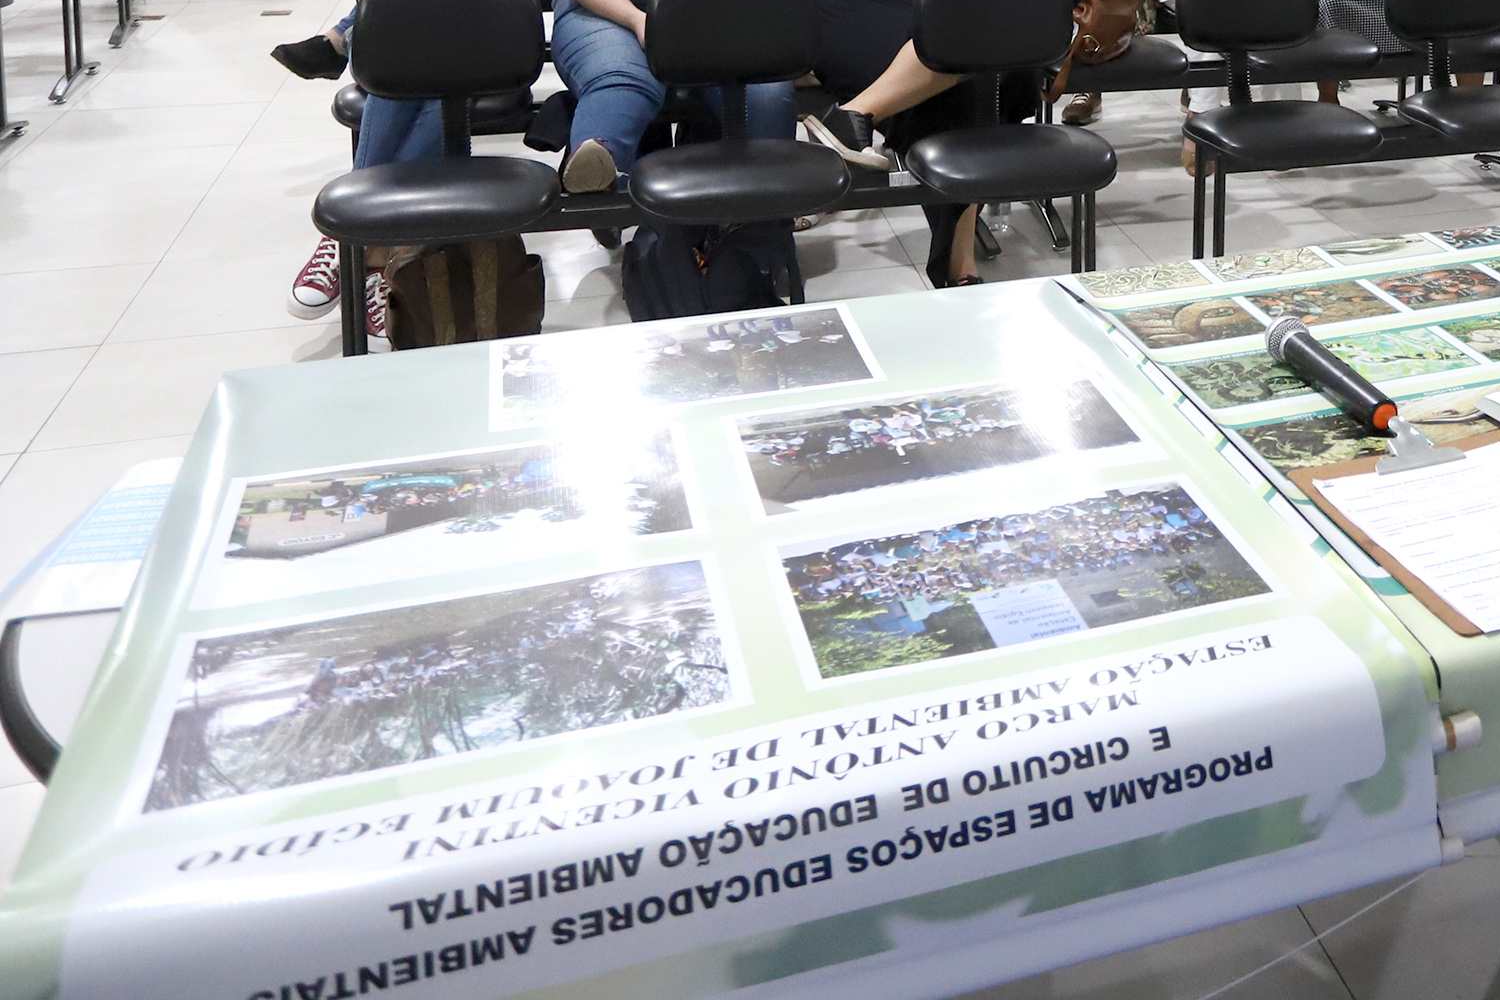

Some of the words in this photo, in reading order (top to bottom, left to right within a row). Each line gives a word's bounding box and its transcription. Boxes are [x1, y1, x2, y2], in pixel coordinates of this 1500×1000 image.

[283, 535, 326, 545] EGYDIO
[992, 610, 1023, 621] Egídio
[1022, 609, 1071, 623] Ambiental
[1029, 624, 1081, 639] Ambiental
[1037, 616, 1076, 628] Estação
[1088, 633, 1276, 686] ESTAÇÃO
[800, 677, 1071, 748] AMBIENTAL
[976, 689, 1142, 741] MARCO
[1148, 725, 1172, 752] E
[711, 736, 783, 772] DE
[722, 728, 959, 801] ANTÔNIO
[961, 736, 1131, 797] CIRCUITO
[1083, 745, 1275, 814] PROGRAMA
[437, 754, 696, 824] JOAQUIM
[900, 777, 951, 813] DE
[1027, 794, 1075, 831] DE
[176, 811, 414, 872] EGÍDIO
[402, 788, 704, 862] VICENTINI
[658, 794, 879, 868] EDUCAÇÃO
[845, 808, 1017, 873] ESPAÇOS
[388, 847, 644, 931] AMBIENTAL
[550, 853, 834, 946] EDUCADORES
